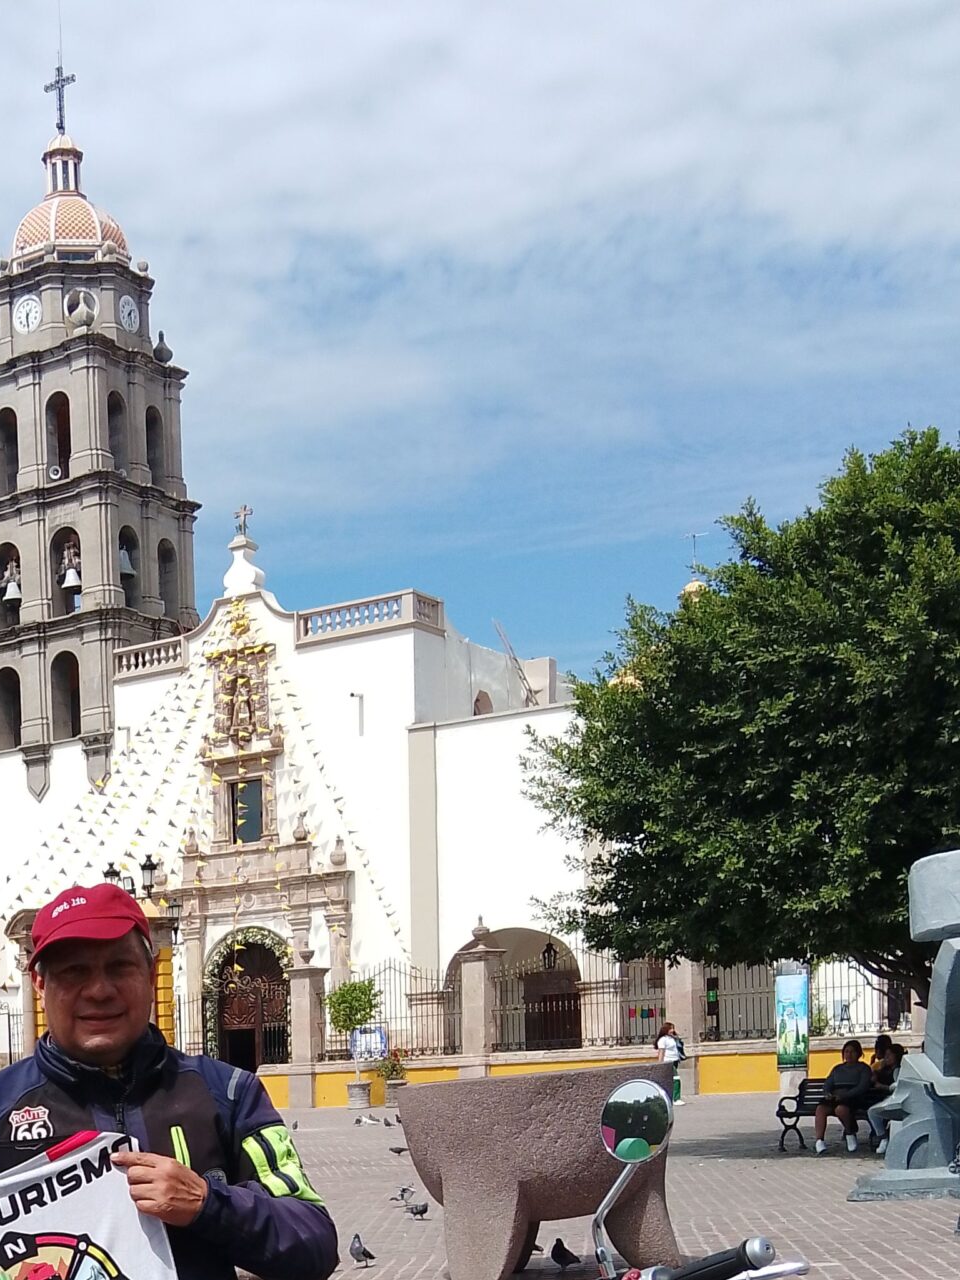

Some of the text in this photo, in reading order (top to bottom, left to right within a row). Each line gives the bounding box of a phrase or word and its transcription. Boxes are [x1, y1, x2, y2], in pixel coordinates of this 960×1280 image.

[13, 1110, 46, 1125] ROUTE
[17, 1121, 47, 1141] 66
[3, 1238, 27, 1259] N
